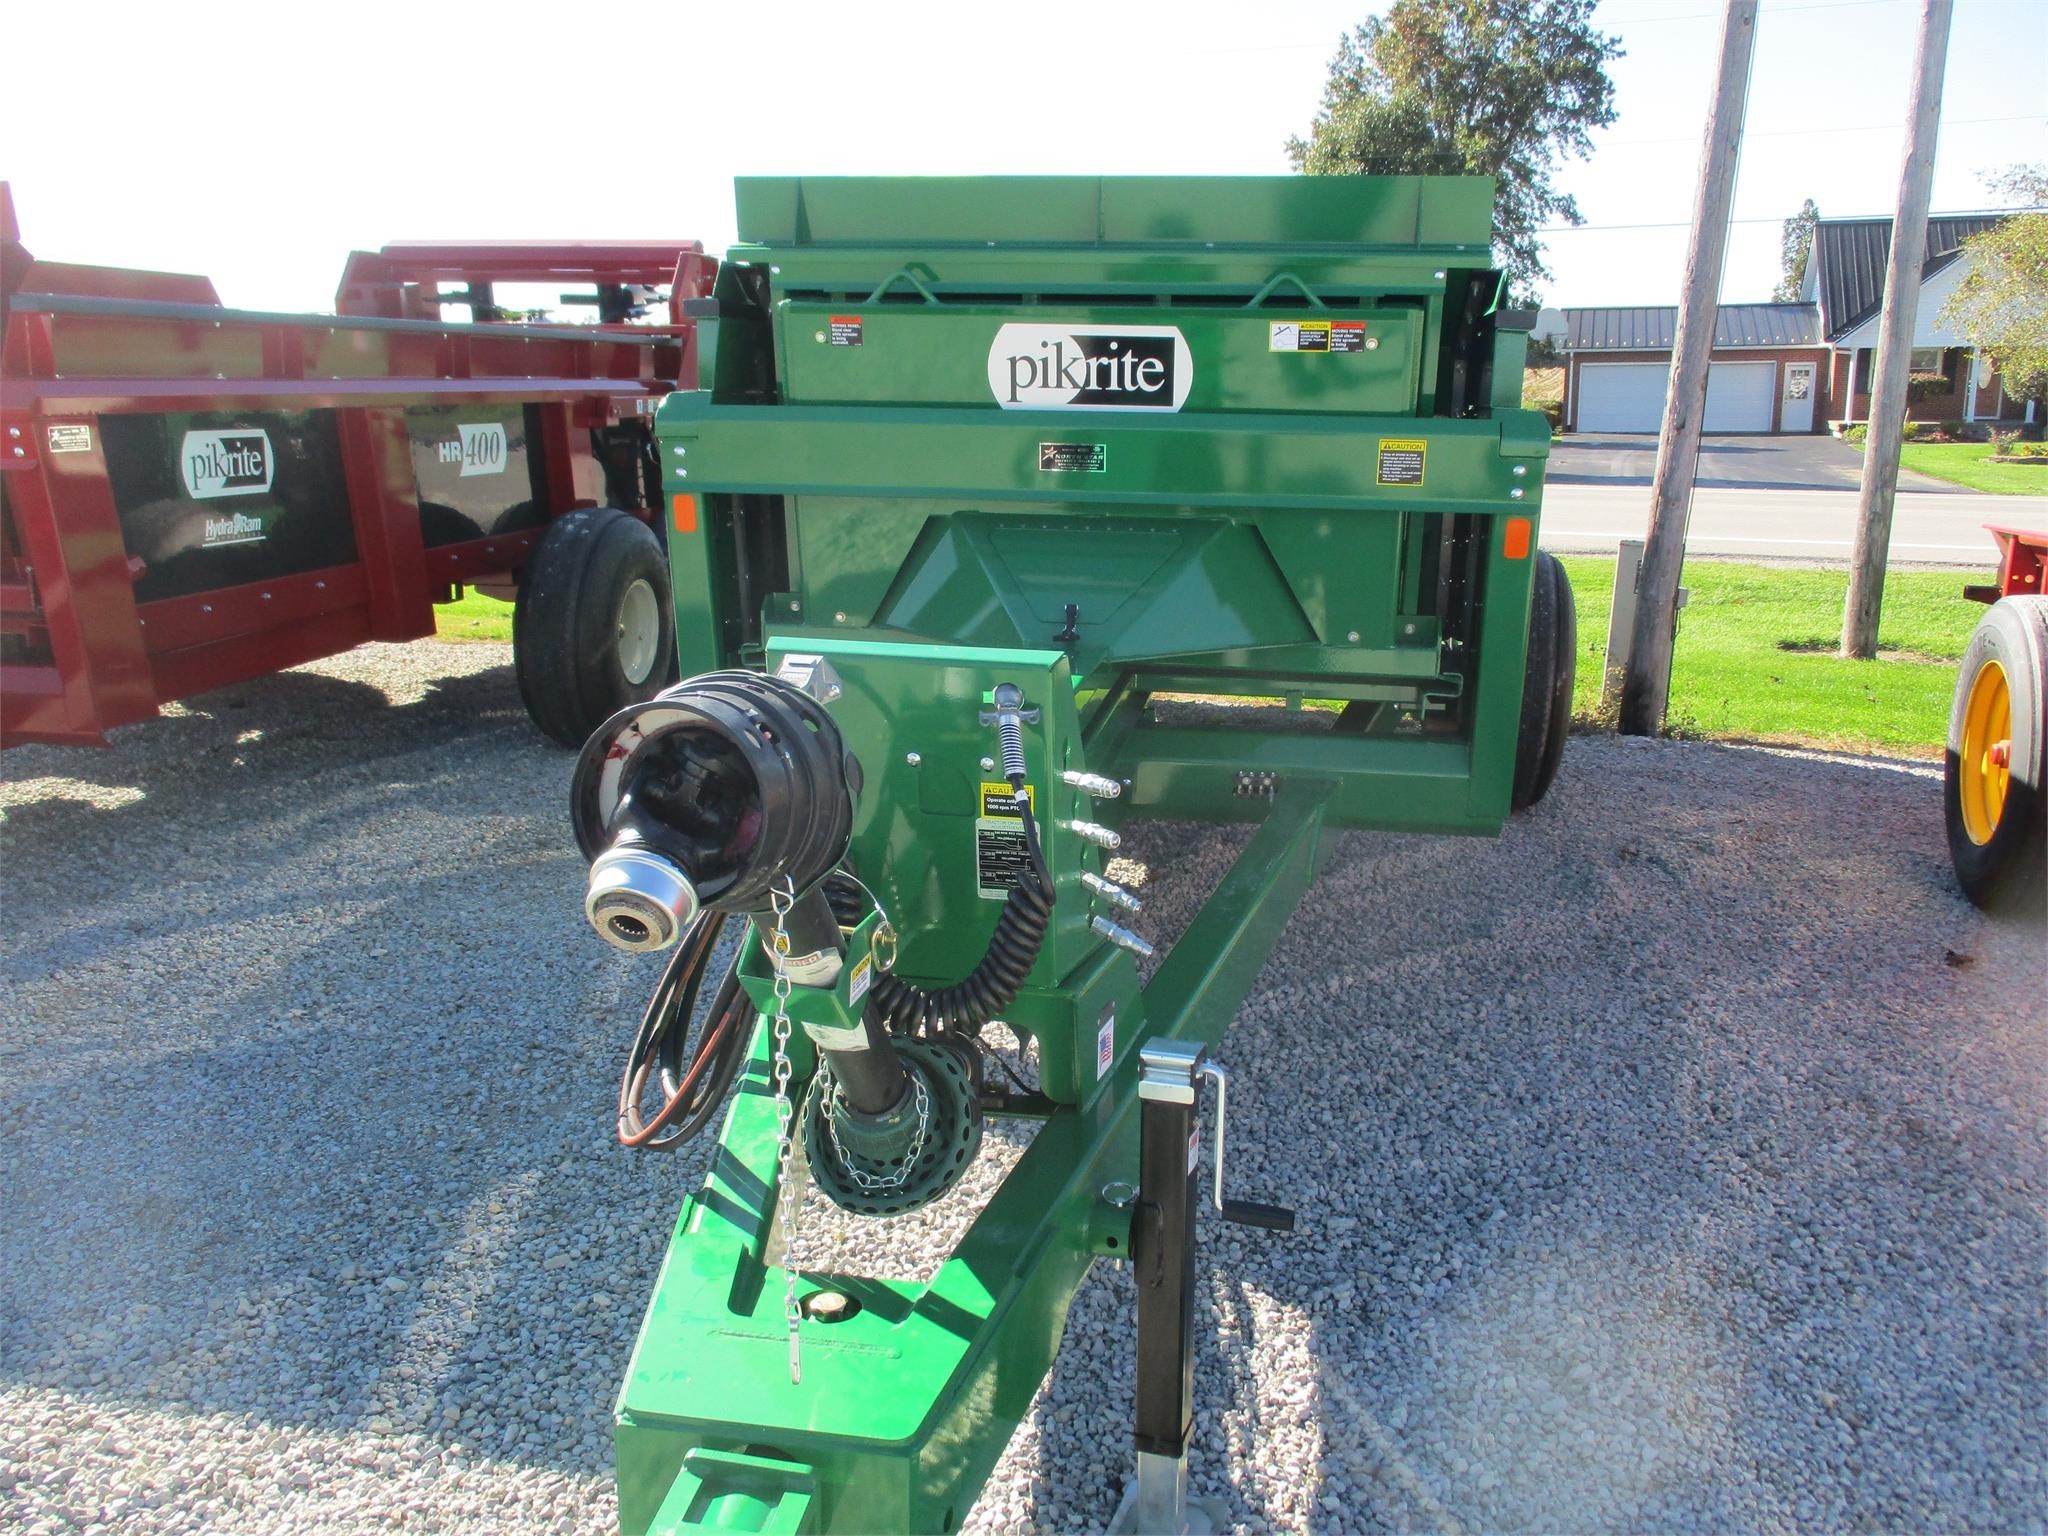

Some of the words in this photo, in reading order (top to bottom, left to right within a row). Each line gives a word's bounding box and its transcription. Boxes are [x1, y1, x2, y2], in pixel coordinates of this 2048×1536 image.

[1006, 341, 1166, 403] pikrite
[192, 442, 263, 491] pikrite
[439, 441, 462, 463] HR
[465, 431, 500, 466] 400
